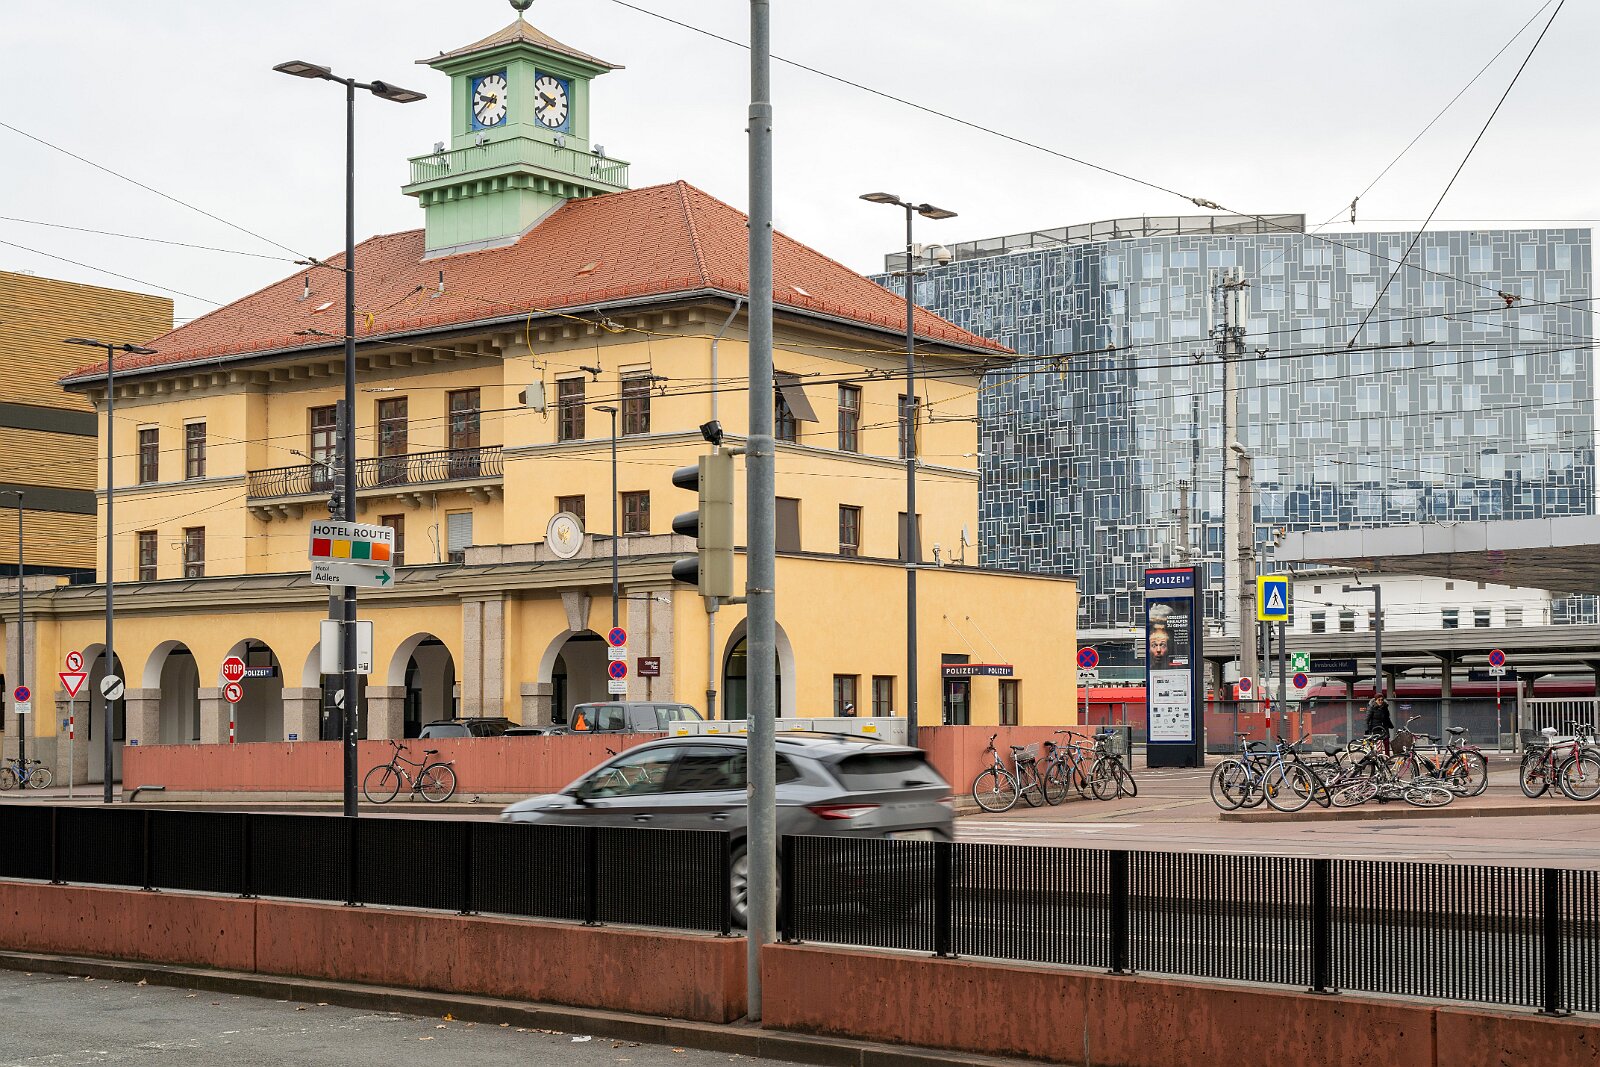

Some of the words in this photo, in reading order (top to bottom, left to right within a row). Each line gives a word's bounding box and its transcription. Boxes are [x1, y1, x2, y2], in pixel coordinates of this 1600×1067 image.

[313, 525, 350, 537] HOTEL
[353, 528, 391, 540] ROUTE
[315, 573, 340, 582] Adlers
[1149, 576, 1185, 585] POLIZEI
[224, 664, 243, 675] STOP
[946, 667, 974, 675] POLIZEI
[988, 667, 1008, 675] POLIZEI
